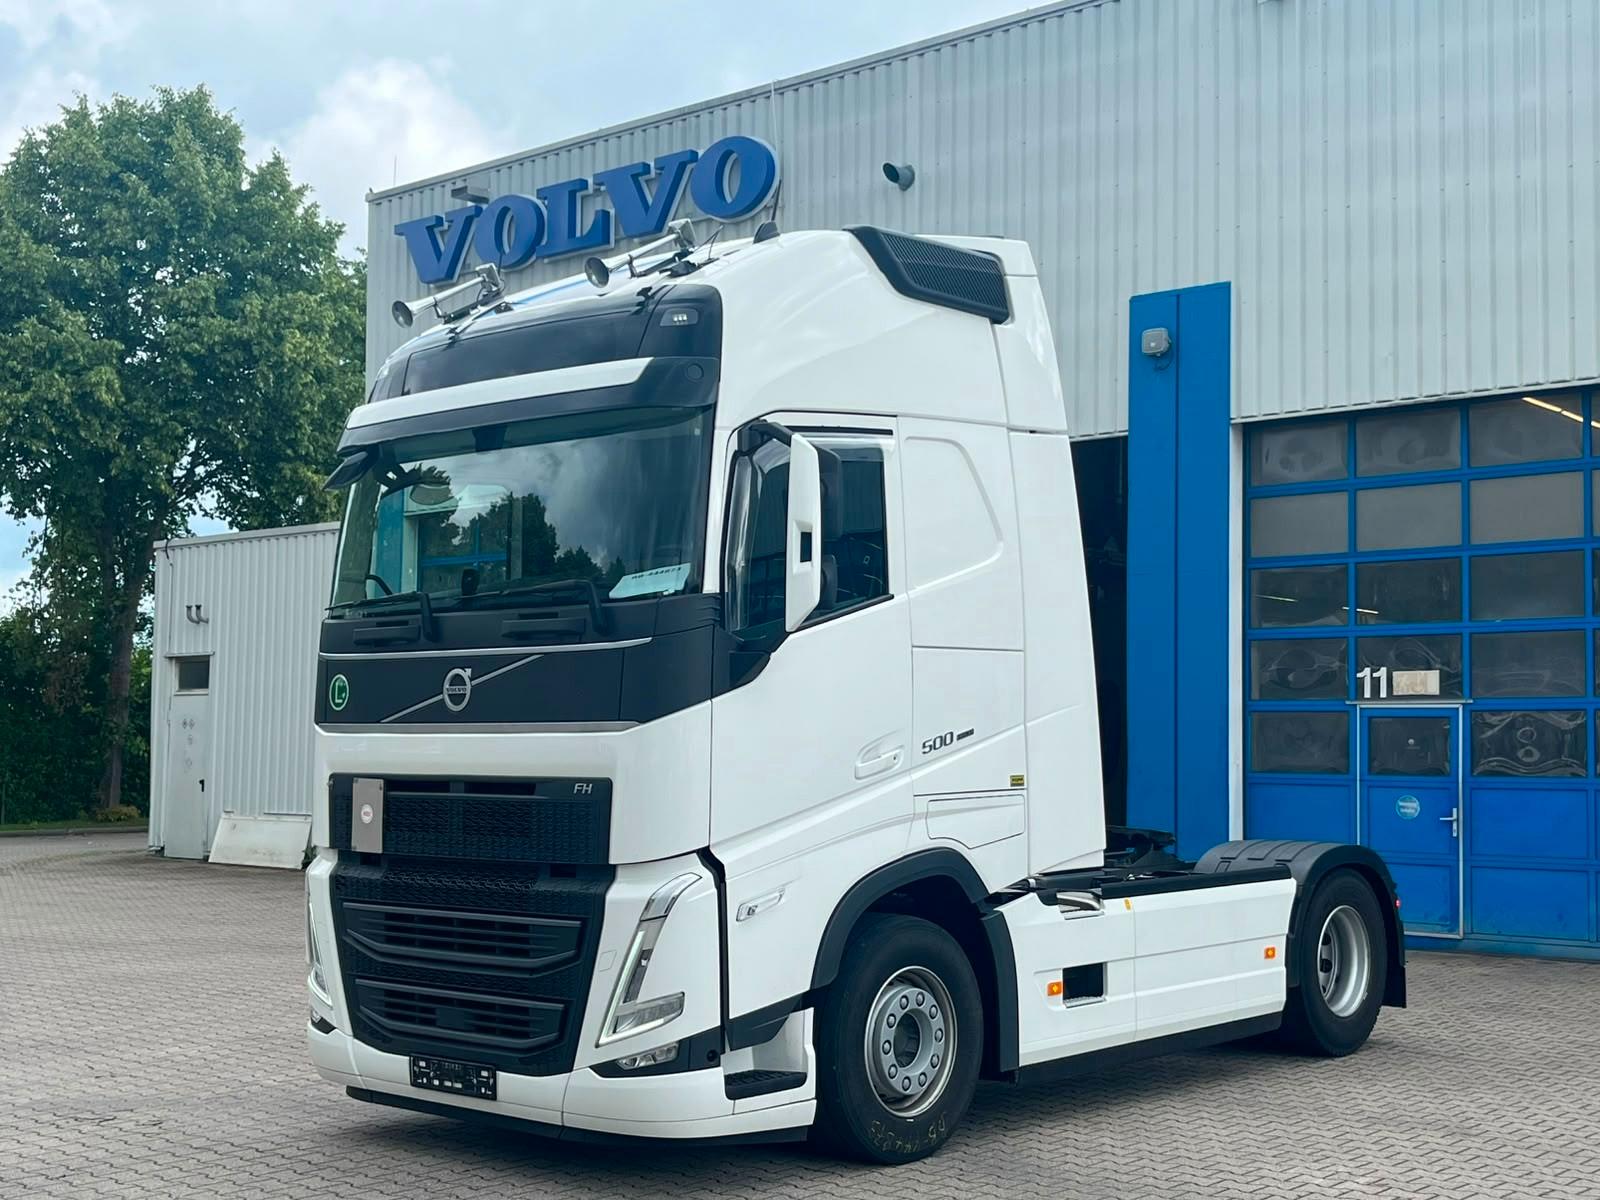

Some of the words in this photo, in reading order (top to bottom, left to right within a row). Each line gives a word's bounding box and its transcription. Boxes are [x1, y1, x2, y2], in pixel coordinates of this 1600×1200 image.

[394, 135, 778, 284] VOLVO
[1356, 666, 1387, 698] 11
[921, 731, 954, 755] 500
[573, 783, 593, 794] FH
